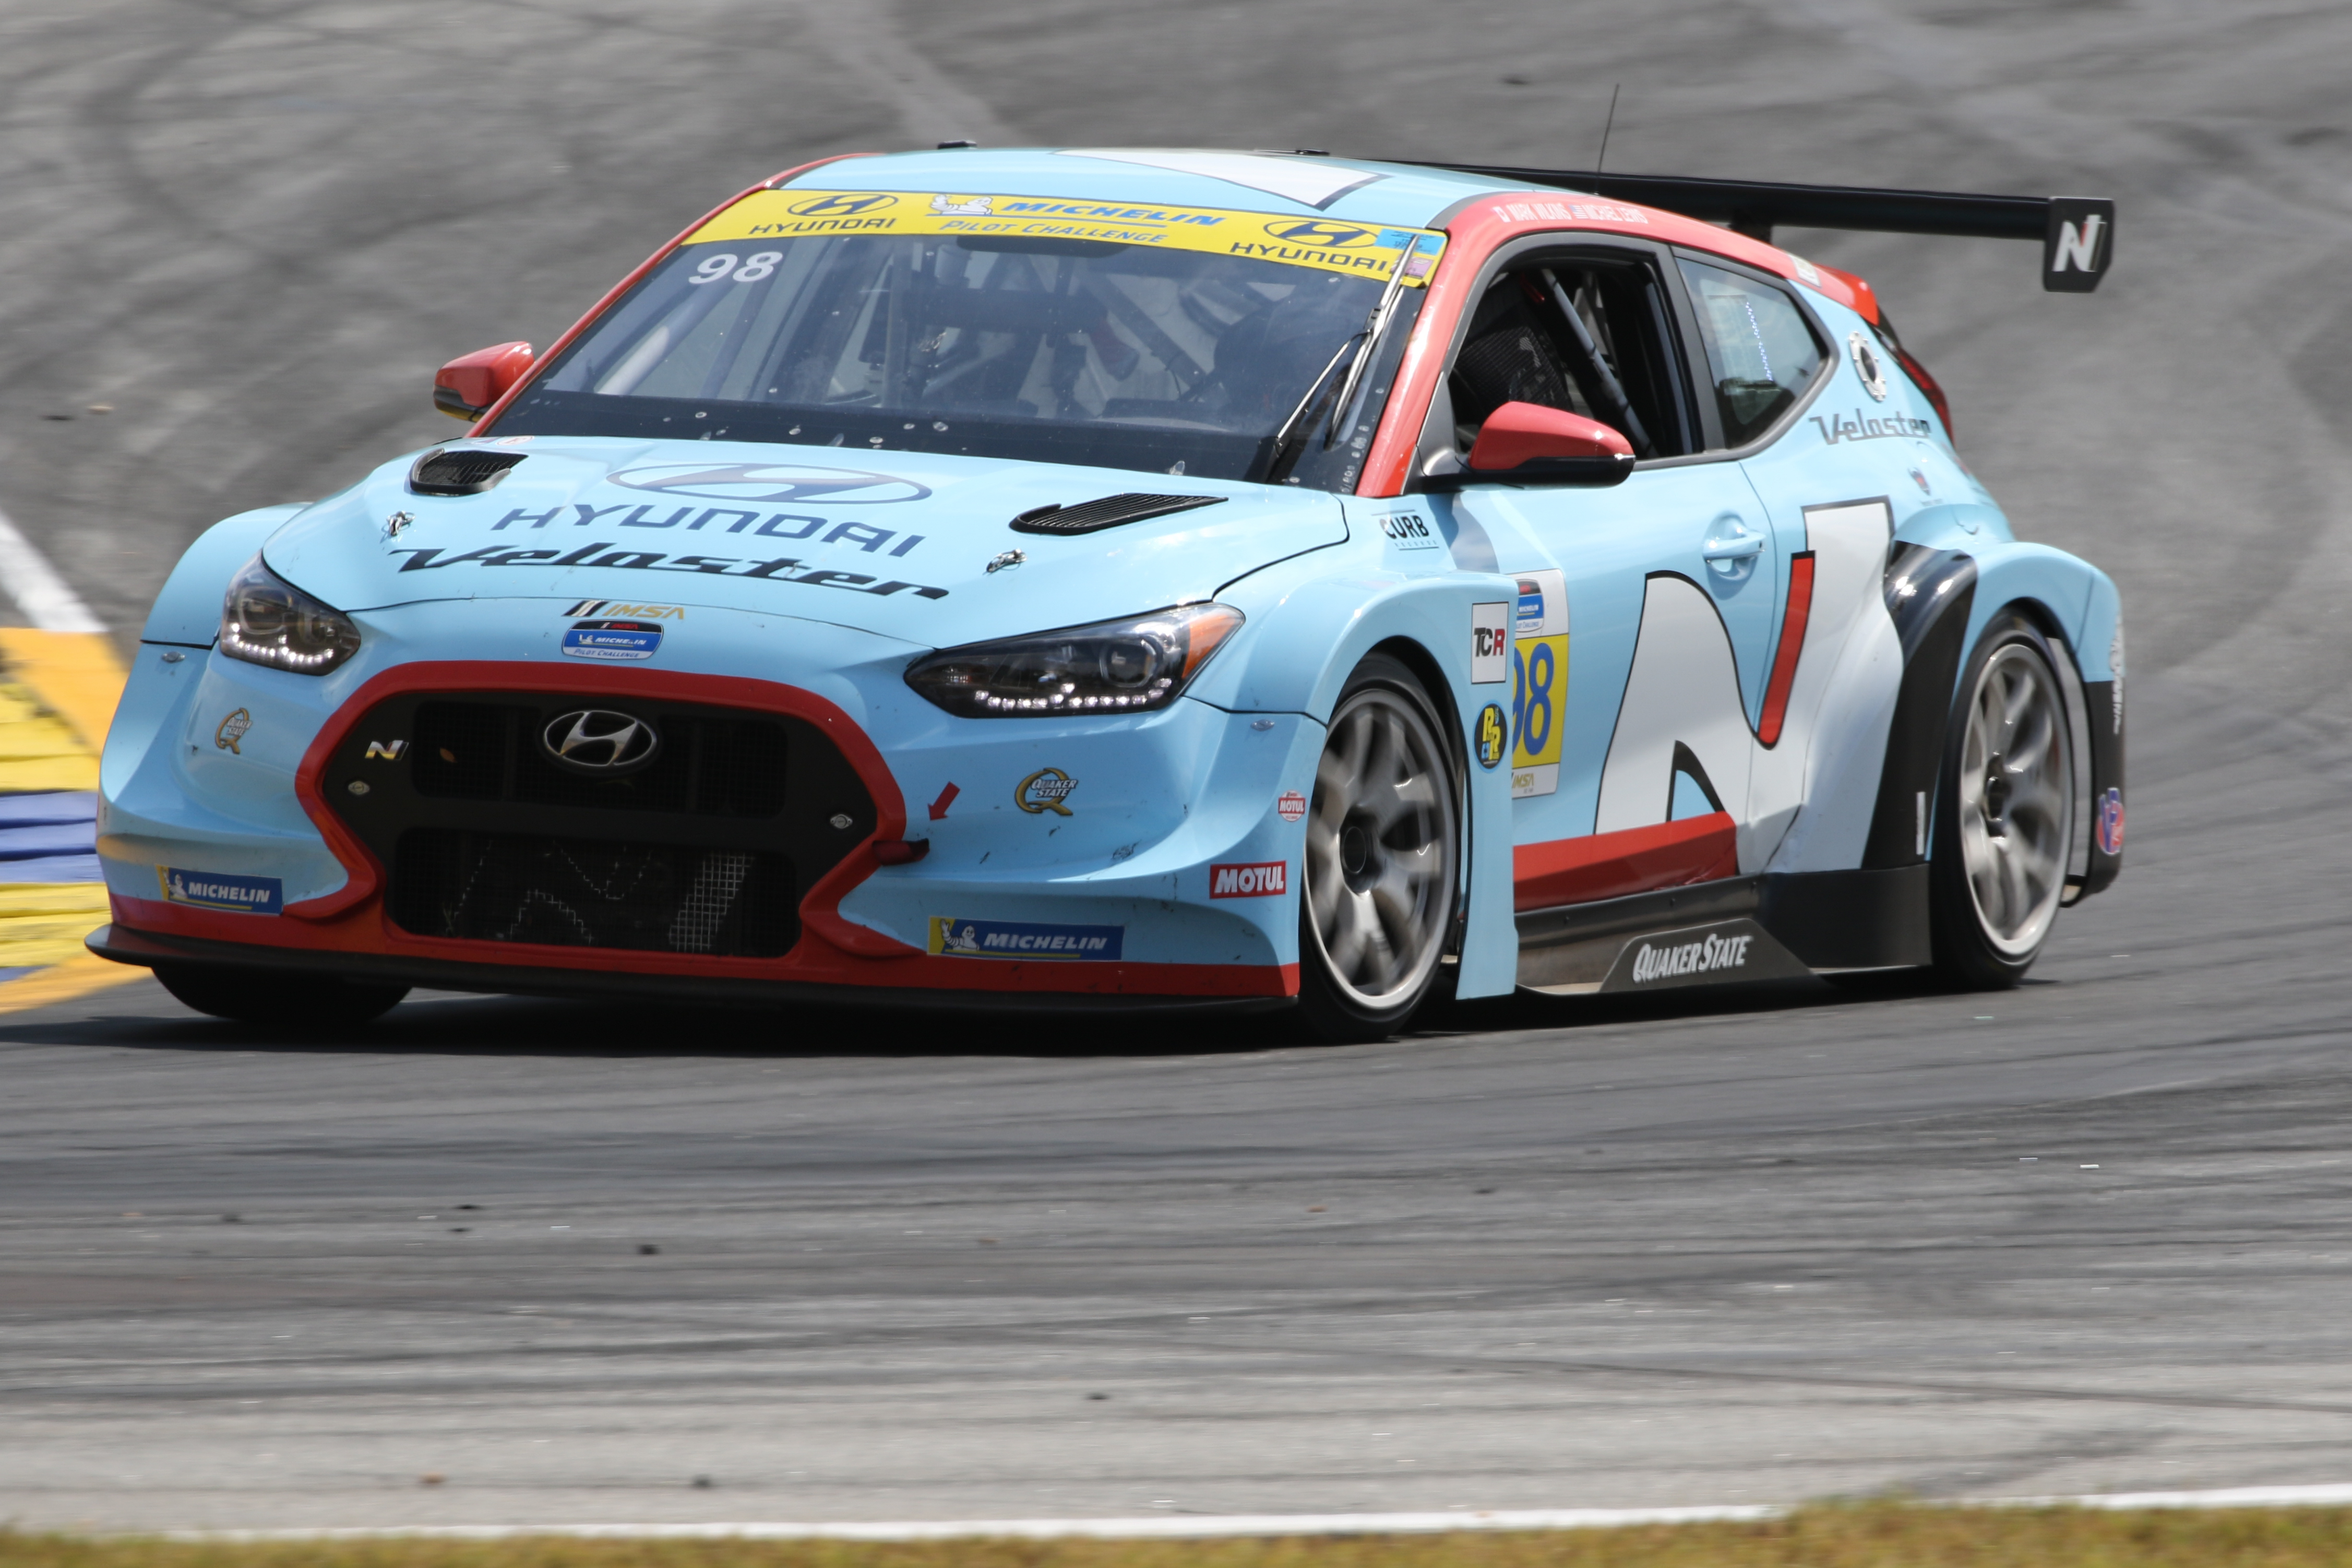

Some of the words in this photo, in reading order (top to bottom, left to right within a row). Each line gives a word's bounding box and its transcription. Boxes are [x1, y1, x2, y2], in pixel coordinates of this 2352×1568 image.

[1000, 202, 1225, 226] MICHELIN
[748, 218, 897, 235] HYUNDAI
[939, 220, 1018, 232] PILOT
[1022, 223, 1168, 242] CHALLENGE
[689, 252, 783, 284] 98
[1230, 243, 1388, 271] HYUNDAI
[1808, 408, 1932, 445] Veloster
[491, 505, 925, 557] HYUNDAI
[1379, 516, 1429, 539] CURB
[389, 542, 949, 600] Veloster
[602, 604, 684, 619] IMSA
[1474, 628, 1505, 657] TCR
[365, 739, 409, 760] N
[1031, 779, 1077, 789] QUAKER
[1036, 788, 1069, 797] STATE
[1280, 800, 1304, 812] MOTUL
[1214, 866, 1284, 894] MOTUL
[188, 881, 270, 903] MICHELIN
[984, 932, 1107, 950] MICHELIN
